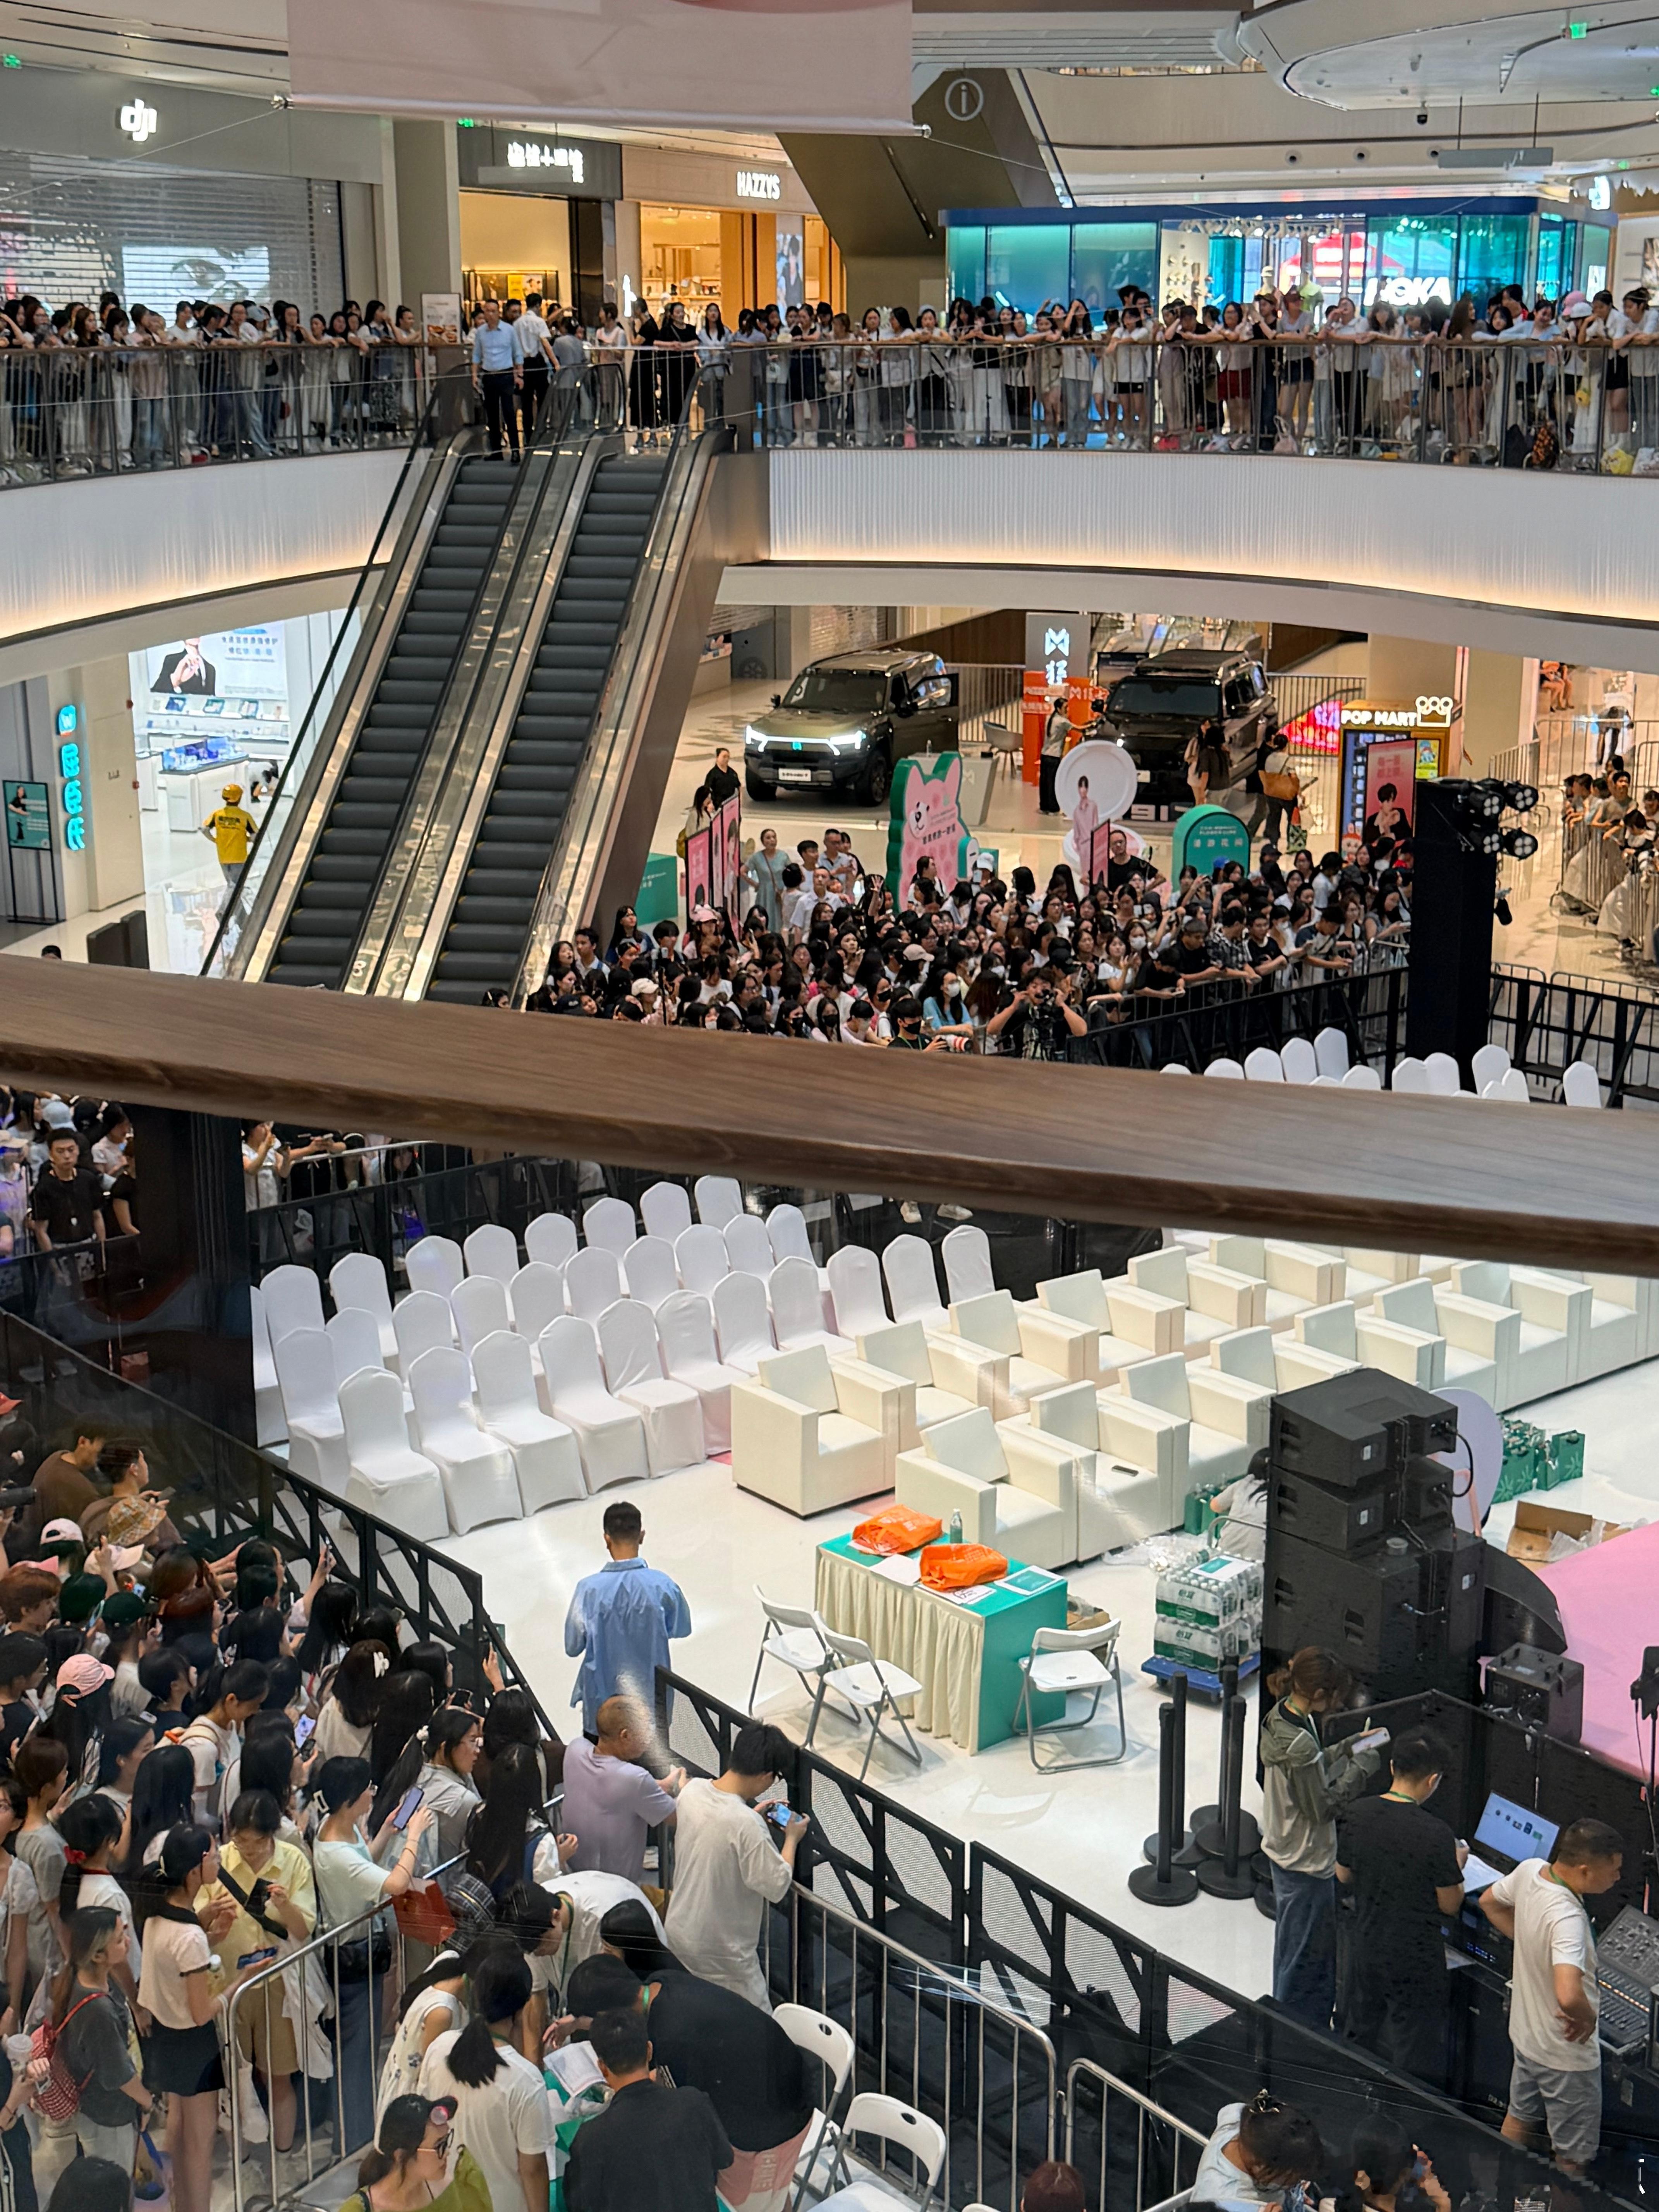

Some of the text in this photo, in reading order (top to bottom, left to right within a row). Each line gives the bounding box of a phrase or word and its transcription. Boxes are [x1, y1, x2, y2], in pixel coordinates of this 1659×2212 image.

[737, 171, 780, 200] HAZZYS
[1341, 709, 1372, 725] POP
[1374, 711, 1417, 726] MART
